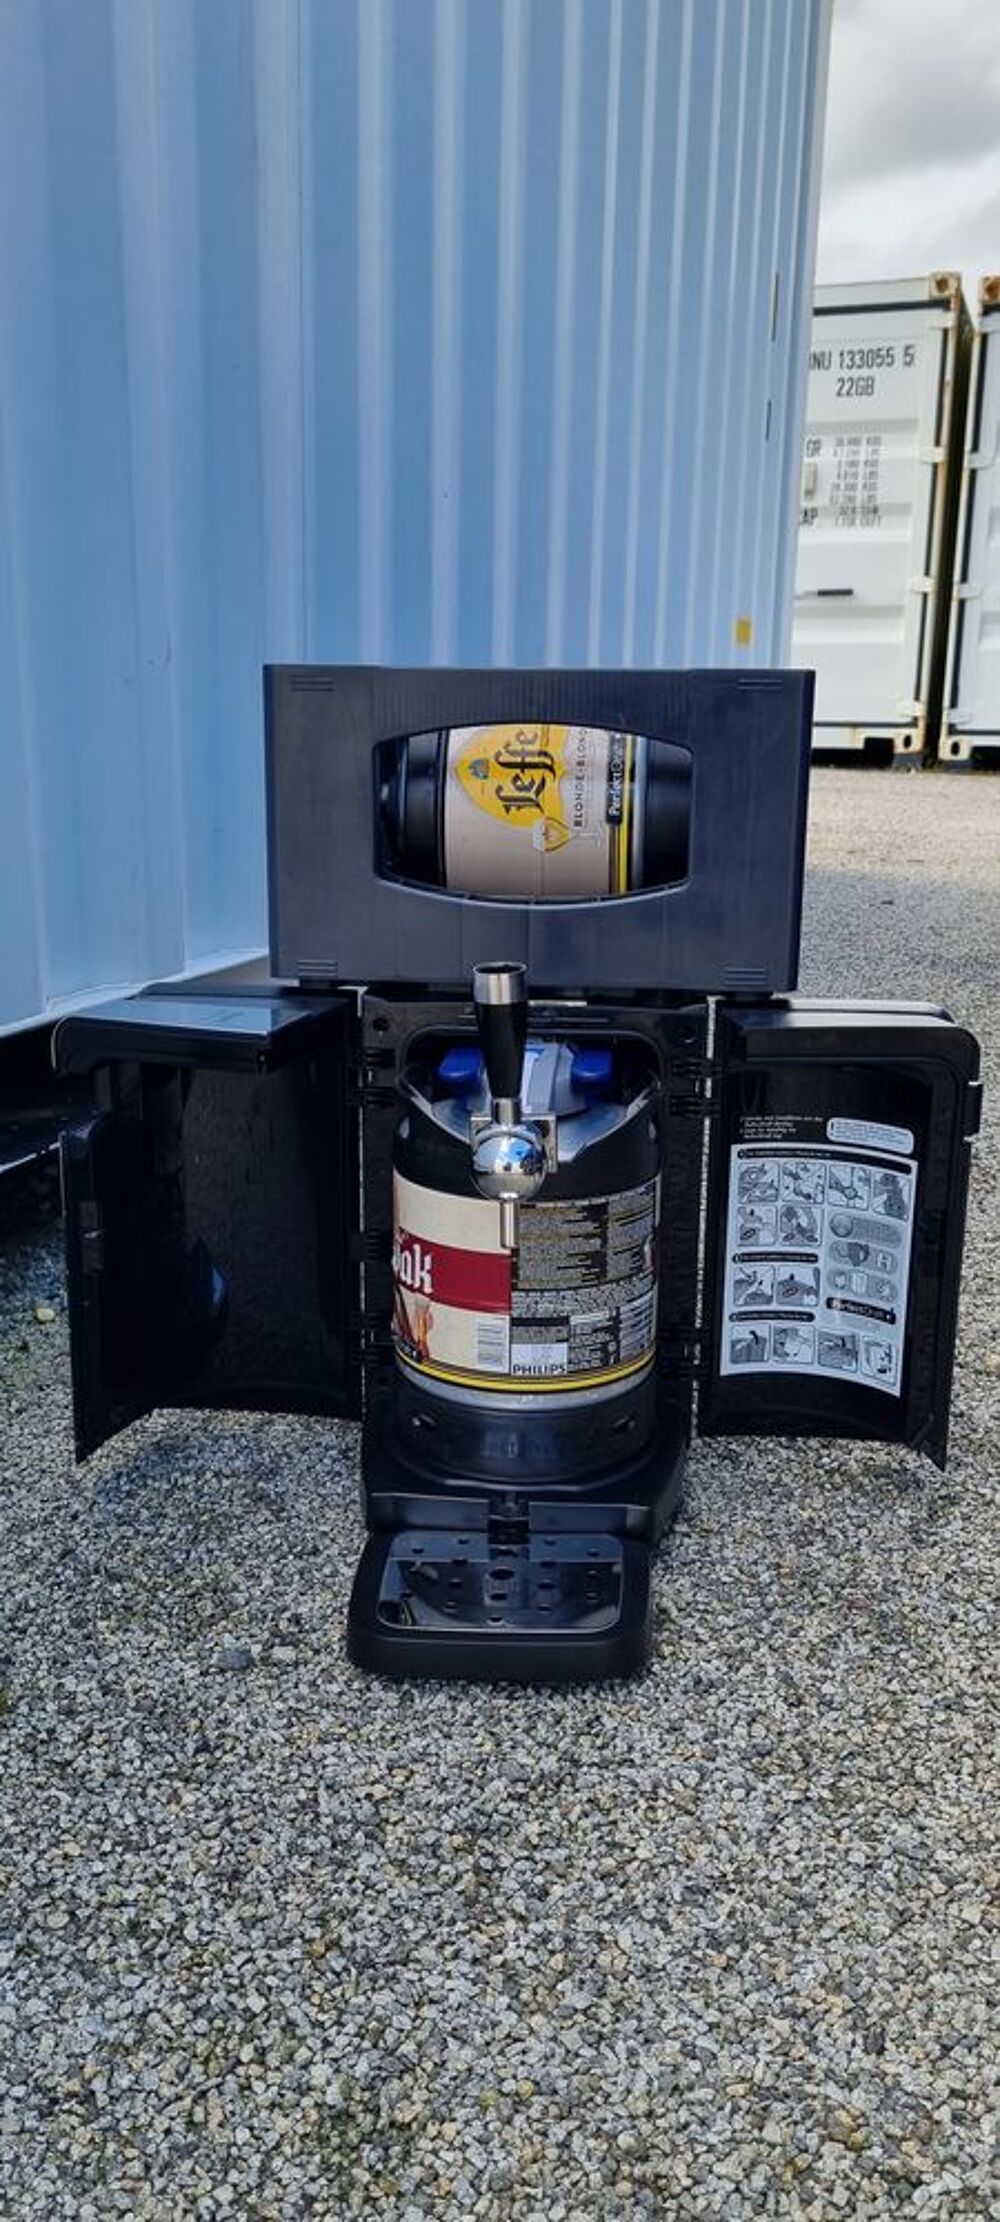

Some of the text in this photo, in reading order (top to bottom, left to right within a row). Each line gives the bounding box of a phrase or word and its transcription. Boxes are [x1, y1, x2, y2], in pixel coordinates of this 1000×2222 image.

[839, 346, 895, 370] 133055
[904, 343, 915, 367] 5
[837, 376, 874, 397] 22GB
[806, 438, 821, 458] GR
[495, 730, 556, 816] Leffe
[513, 1364, 566, 1374] PHILIPS
